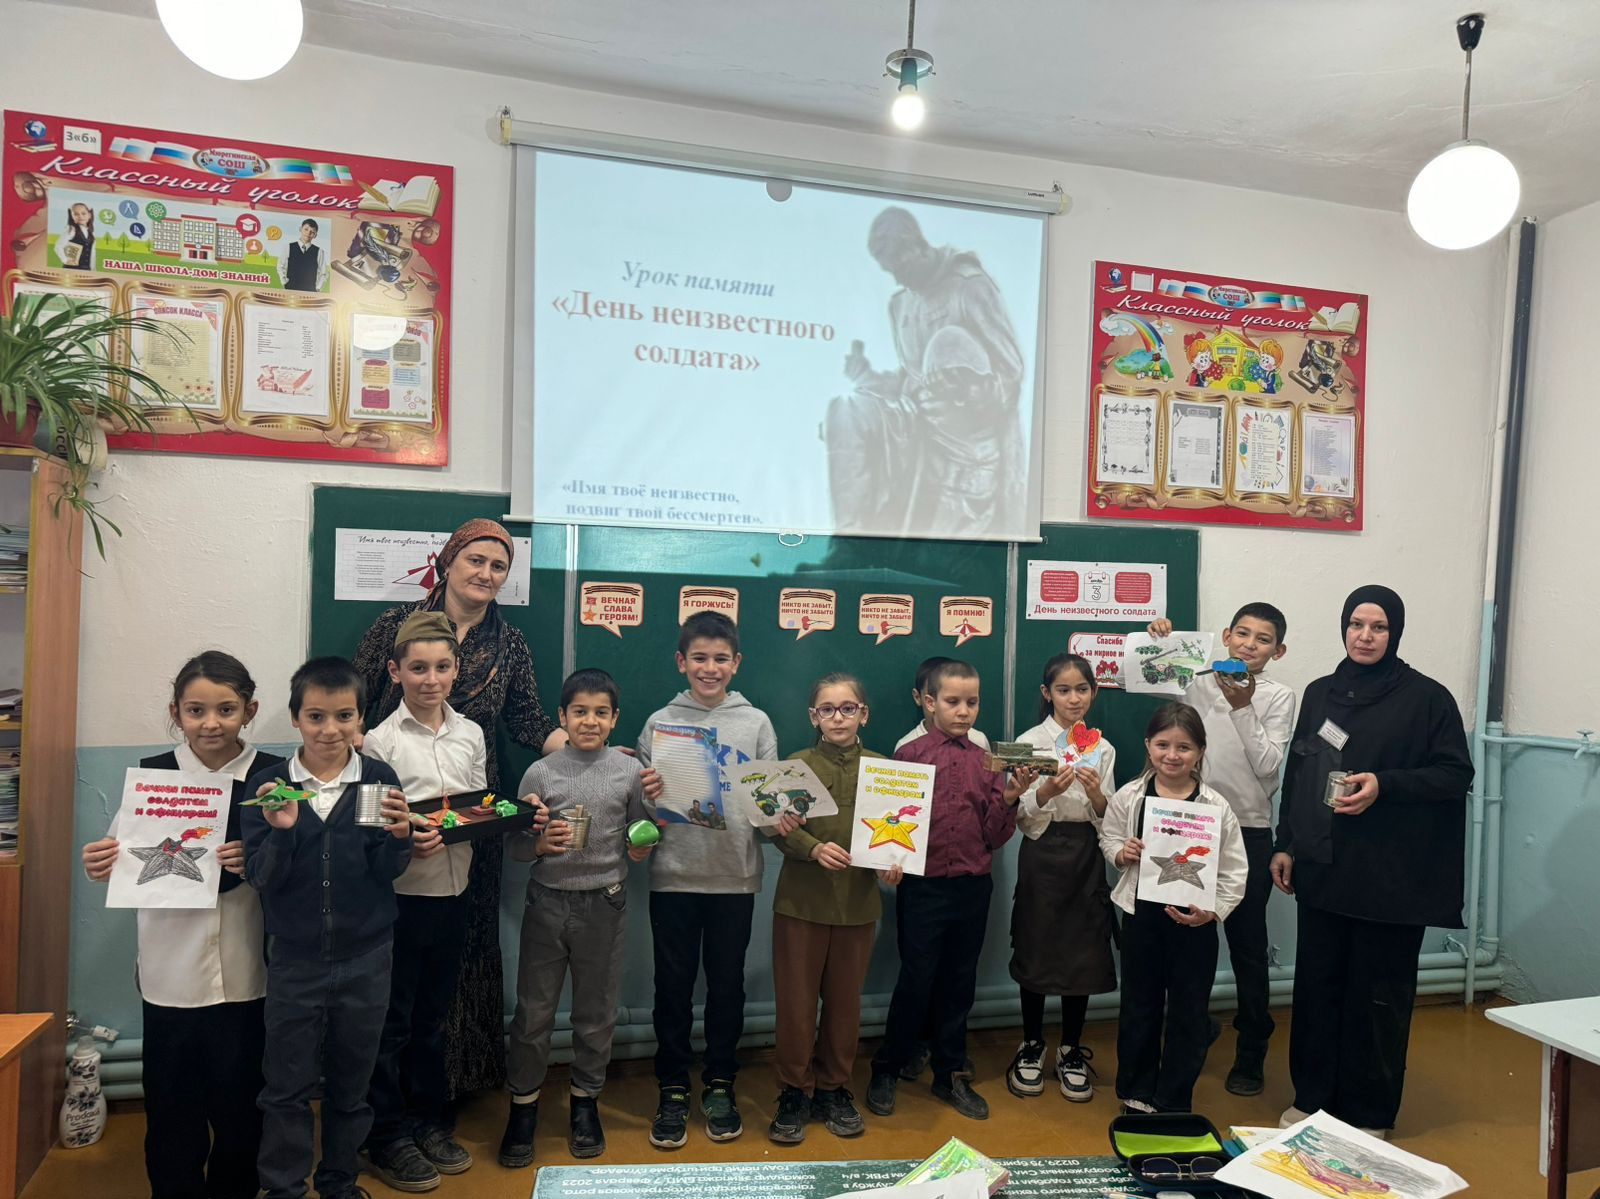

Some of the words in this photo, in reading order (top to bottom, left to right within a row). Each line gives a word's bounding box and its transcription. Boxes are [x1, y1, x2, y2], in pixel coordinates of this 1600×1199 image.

[217, 159, 246, 169] СОШ
[40, 155, 236, 195] Классный
[248, 185, 360, 211] уголок
[104, 260, 142, 271] НАША
[220, 271, 270, 283] ЗНАНИЙ
[621, 261, 680, 288] Урок
[684, 275, 776, 298] памяти
[179, 307, 203, 318] КЛАССА
[551, 290, 644, 322] «День
[652, 305, 836, 342] неизвестного
[1117, 294, 1231, 321] Классный
[1241, 314, 1309, 330] уголок
[634, 342, 761, 372] солдата»
[562, 480, 606, 496] «Имя
[611, 484, 646, 498] твоё
[650, 488, 740, 504] неизвестно,
[566, 503, 624, 518] подвиг
[627, 505, 663, 520] твой
[1092, 585, 1102, 600] 3
[600, 596, 636, 605] ВЕЧНАЯ
[690, 600, 735, 609] ГОРЖУСЬ!
[603, 605, 633, 613] СЛАВА
[953, 609, 986, 617] ПОМНЮ!
[1034, 605, 1057, 614] День
[1060, 607, 1120, 616] неизвестного
[1122, 607, 1157, 616] солдата
[599, 613, 639, 622] ГЕРОЯМ!
[1096, 636, 1123, 646] Спасибо
[1094, 649, 1117, 658] мирное
[1014, 1168, 1038, 1176] Сил
[652, 1177, 661, 1185] 7
[1040, 1185, 1144, 1195] осударственного
